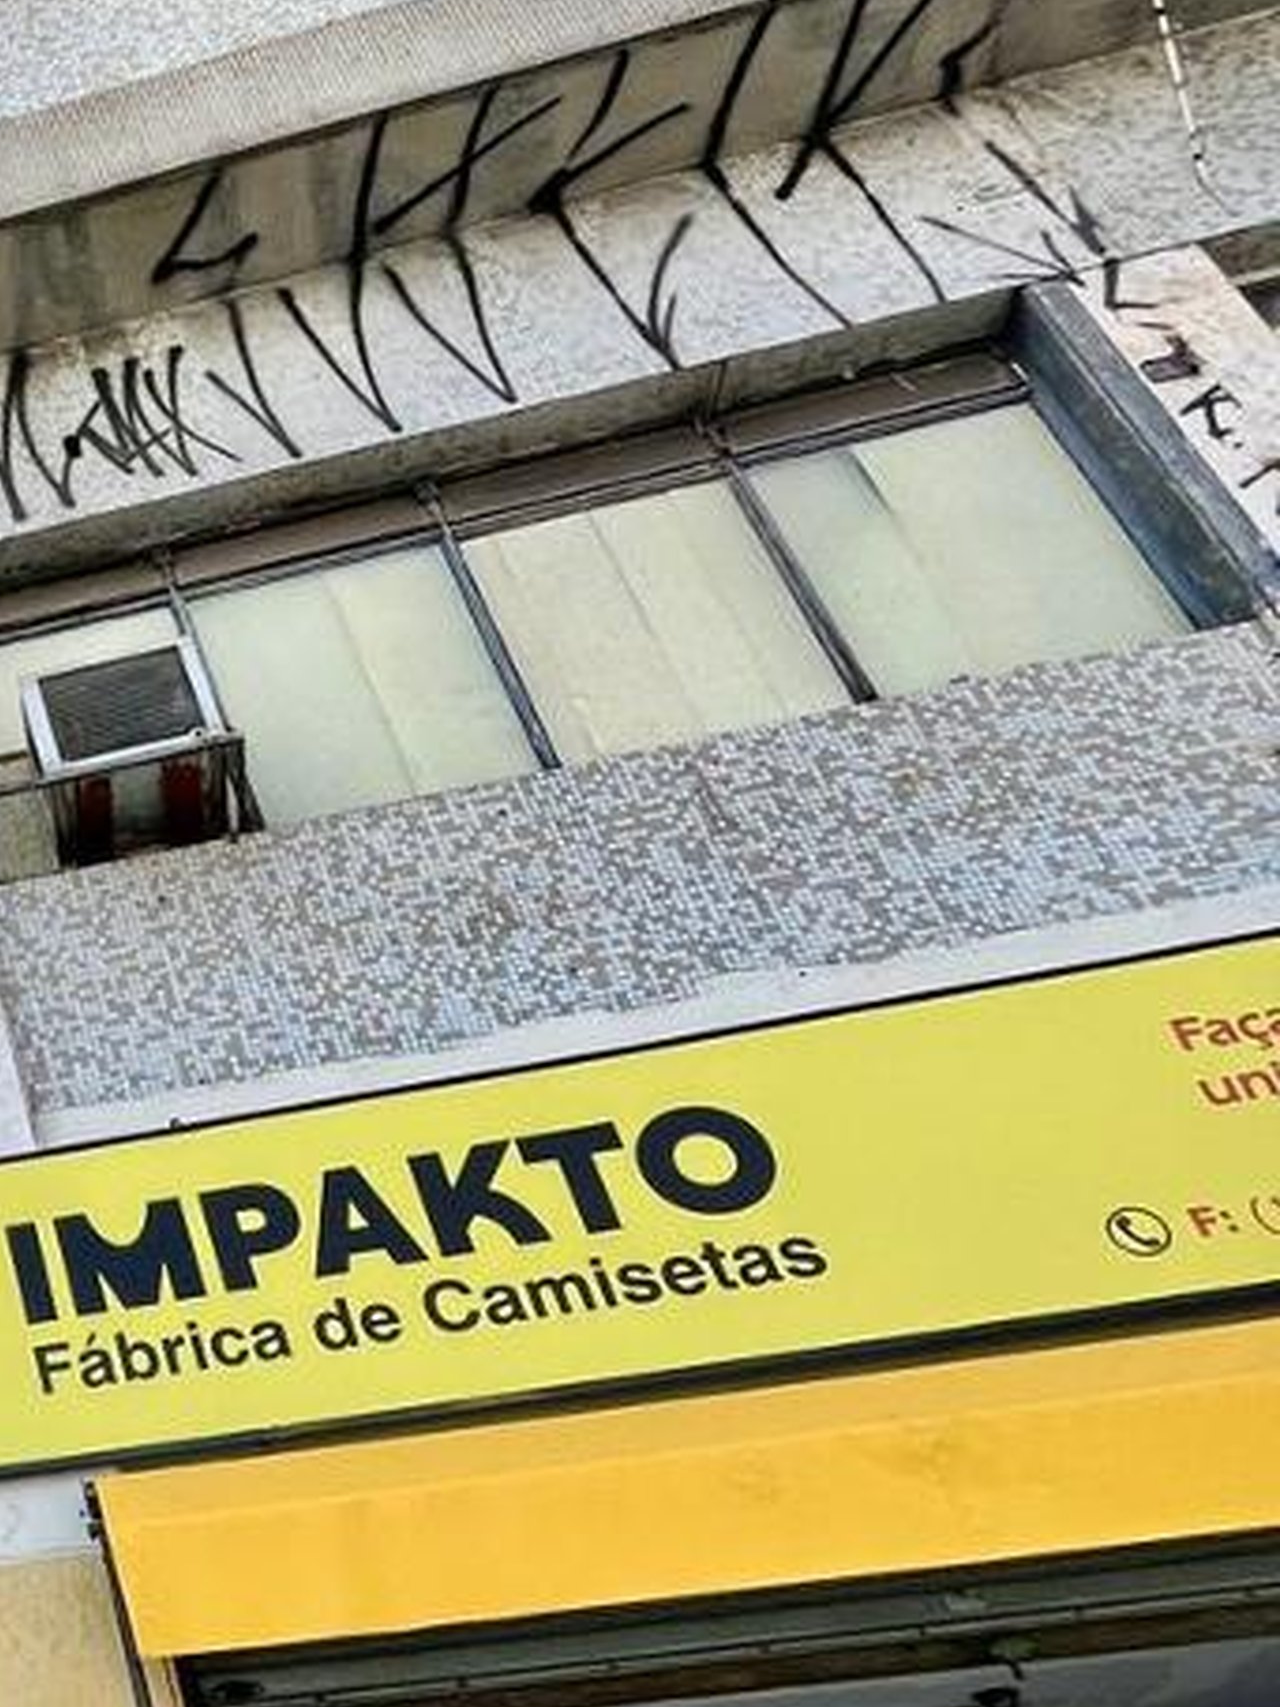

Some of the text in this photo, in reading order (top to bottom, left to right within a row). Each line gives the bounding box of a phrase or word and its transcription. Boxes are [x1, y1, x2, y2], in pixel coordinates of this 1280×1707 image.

[4, 1106, 777, 1324] IMPAKTO
[34, 1232, 829, 1394] Fábrica de Camisetas
